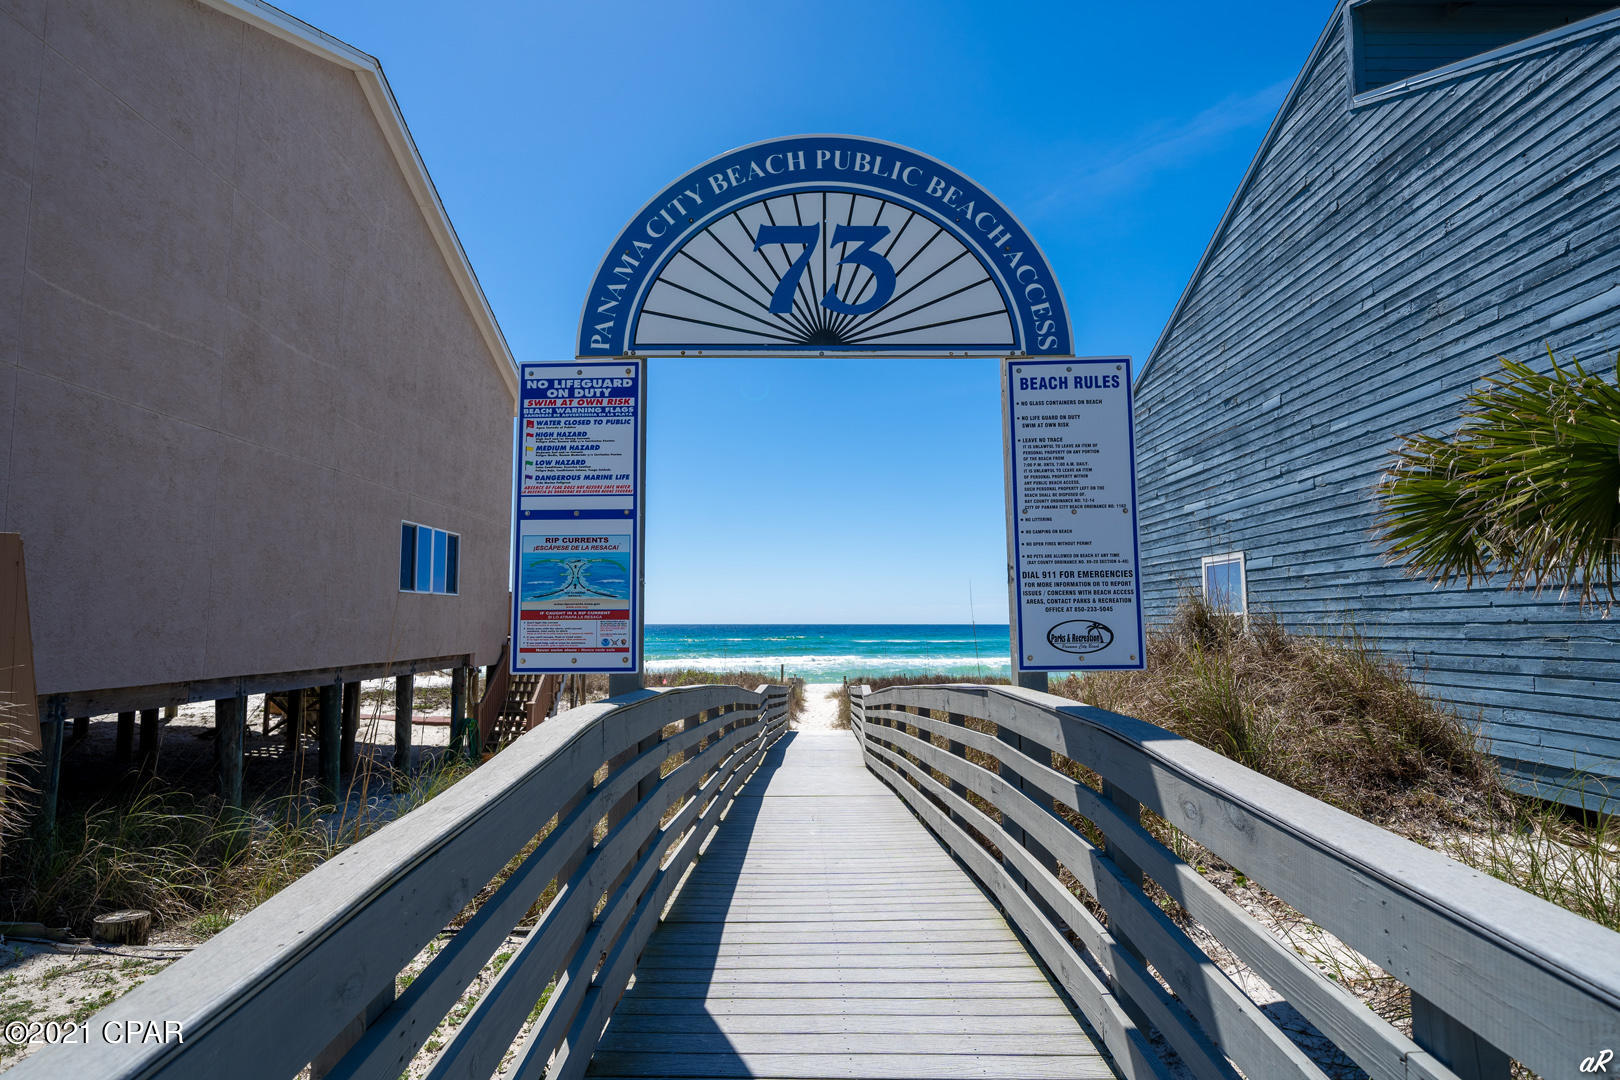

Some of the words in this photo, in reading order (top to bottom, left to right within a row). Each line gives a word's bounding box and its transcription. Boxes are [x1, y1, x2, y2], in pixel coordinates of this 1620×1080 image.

[591, 240, 653, 350] PANAMA
[646, 184, 703, 238] CITY
[708, 150, 806, 195] BEACH
[816, 150, 923, 187] PUBLIC
[926, 176, 1011, 249] BEACH
[1004, 251, 1057, 350] ACCESS
[753, 222, 896, 315] 73
[527, 380, 548, 389] NO
[554, 379, 633, 388] LIFEGUARD
[1020, 376, 1068, 390] BEACH
[1074, 375, 1120, 389] RULES
[547, 389, 568, 397] ON
[574, 388, 611, 397] DUTY
[1051, 634, 1066, 642] Parks
[1067, 634, 1071, 642] &
[1072, 634, 1100, 642] Recreation
